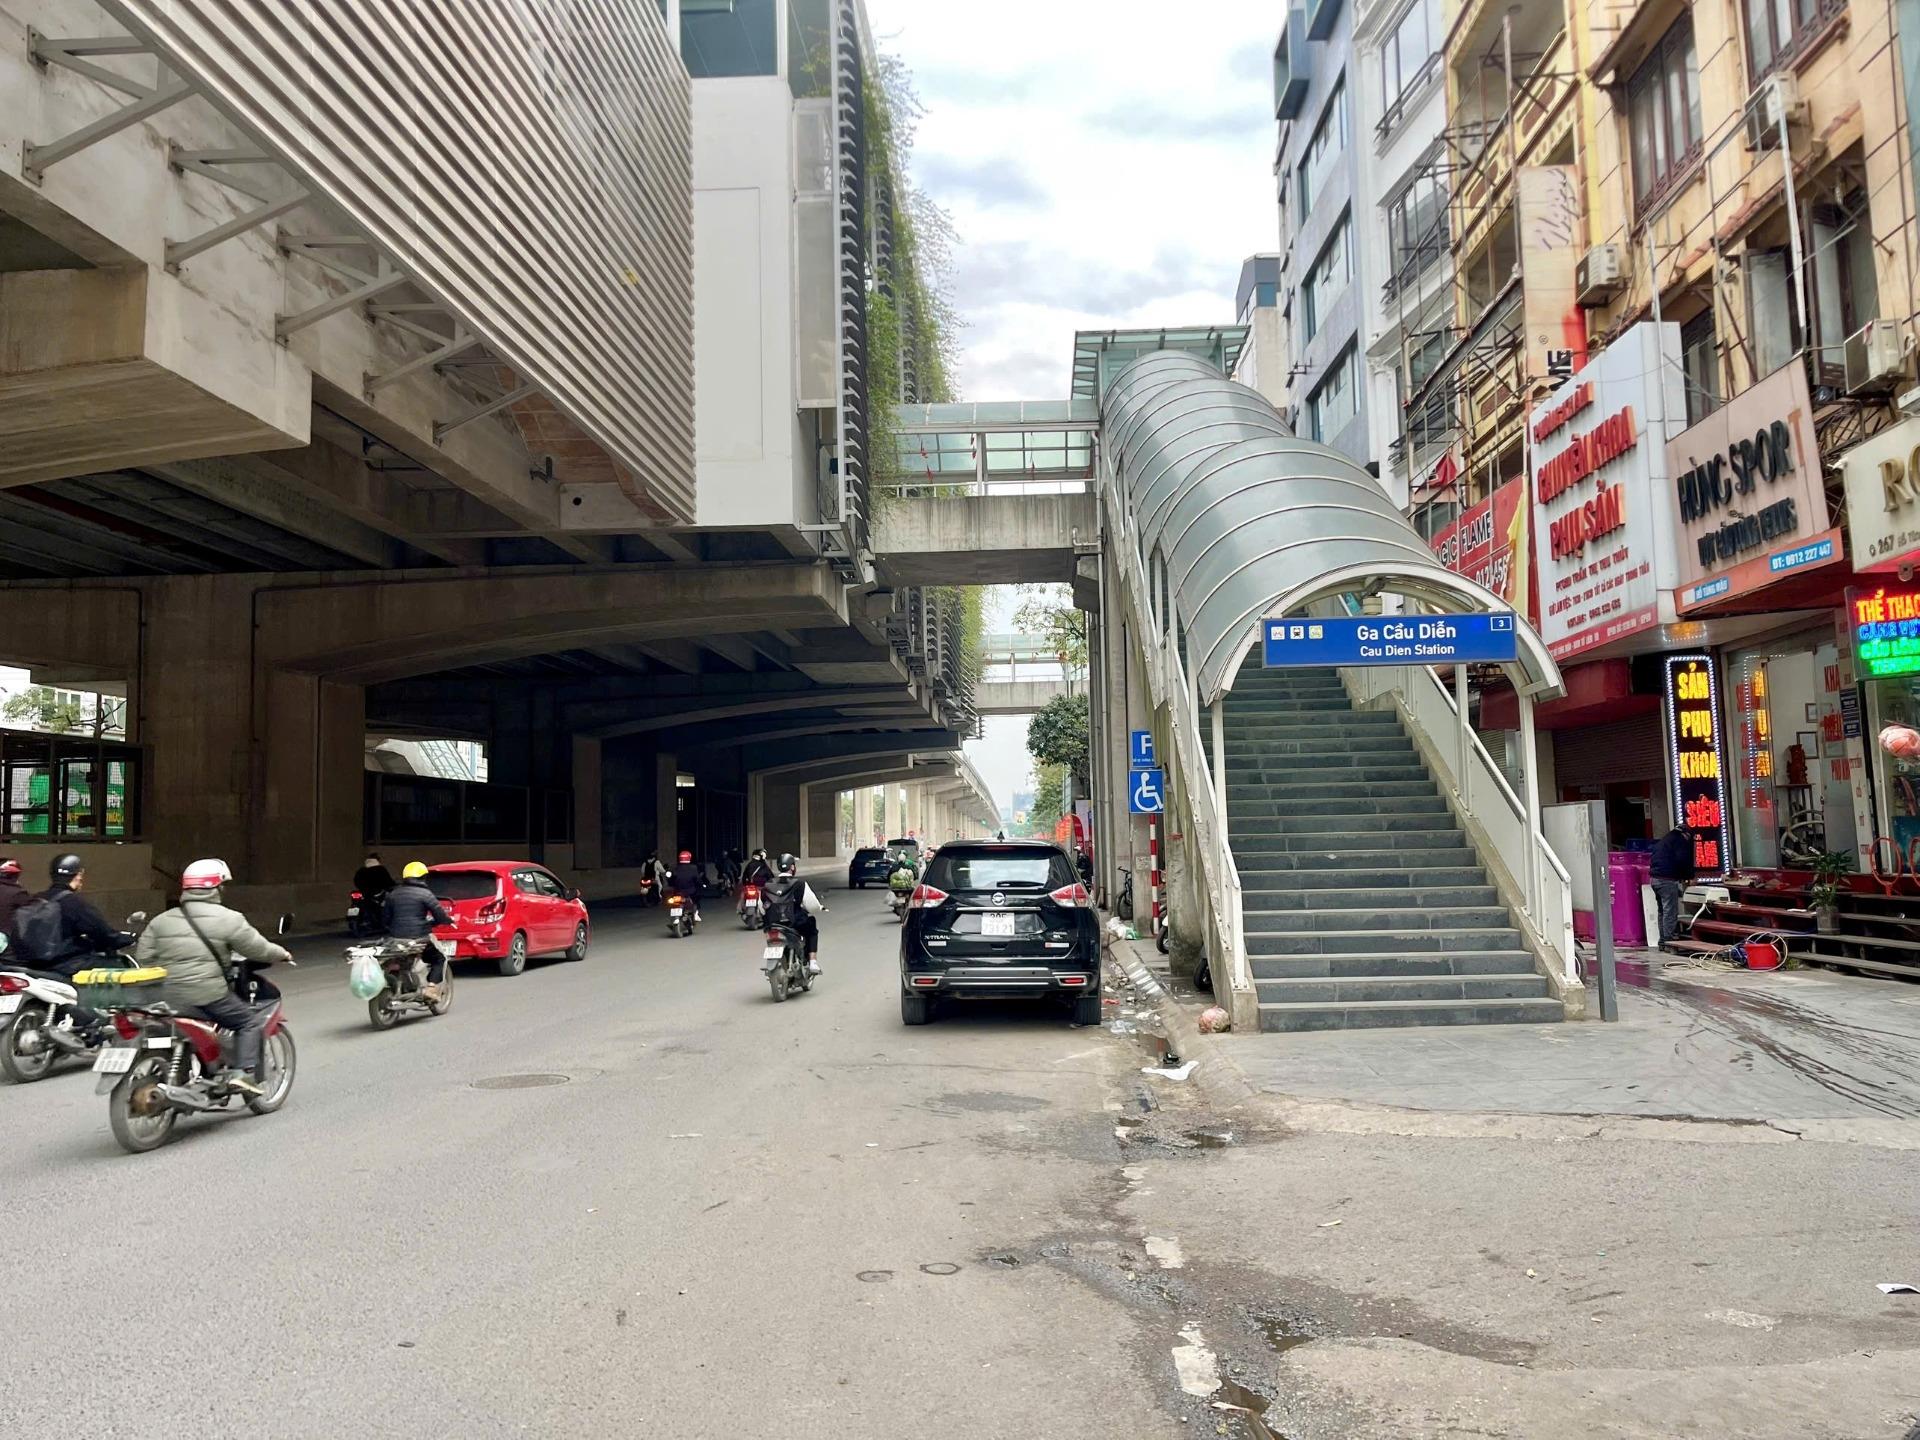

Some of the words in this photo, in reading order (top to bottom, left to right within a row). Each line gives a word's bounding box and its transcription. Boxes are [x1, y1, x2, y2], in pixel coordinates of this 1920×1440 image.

[1590, 406, 1636, 471] KHOA
[1729, 408, 1805, 496] SPORT
[1460, 509, 1494, 556] FLAME
[1549, 507, 1584, 561] PHỤ
[1584, 480, 1625, 541] SẢN
[1357, 625, 1379, 641] Ga
[1383, 621, 1414, 640] Cầu
[1419, 620, 1456, 639] Diễn
[1498, 620, 1504, 628] 3
[1360, 645, 1382, 657] Cau
[1385, 644, 1412, 656] Dien
[1414, 643, 1455, 655] Station
[1678, 663, 1709, 700] SẢN
[1681, 710, 1712, 743] PHỤ
[1680, 751, 1720, 779] KHOA
[1686, 793, 1720, 828] SIÊU
